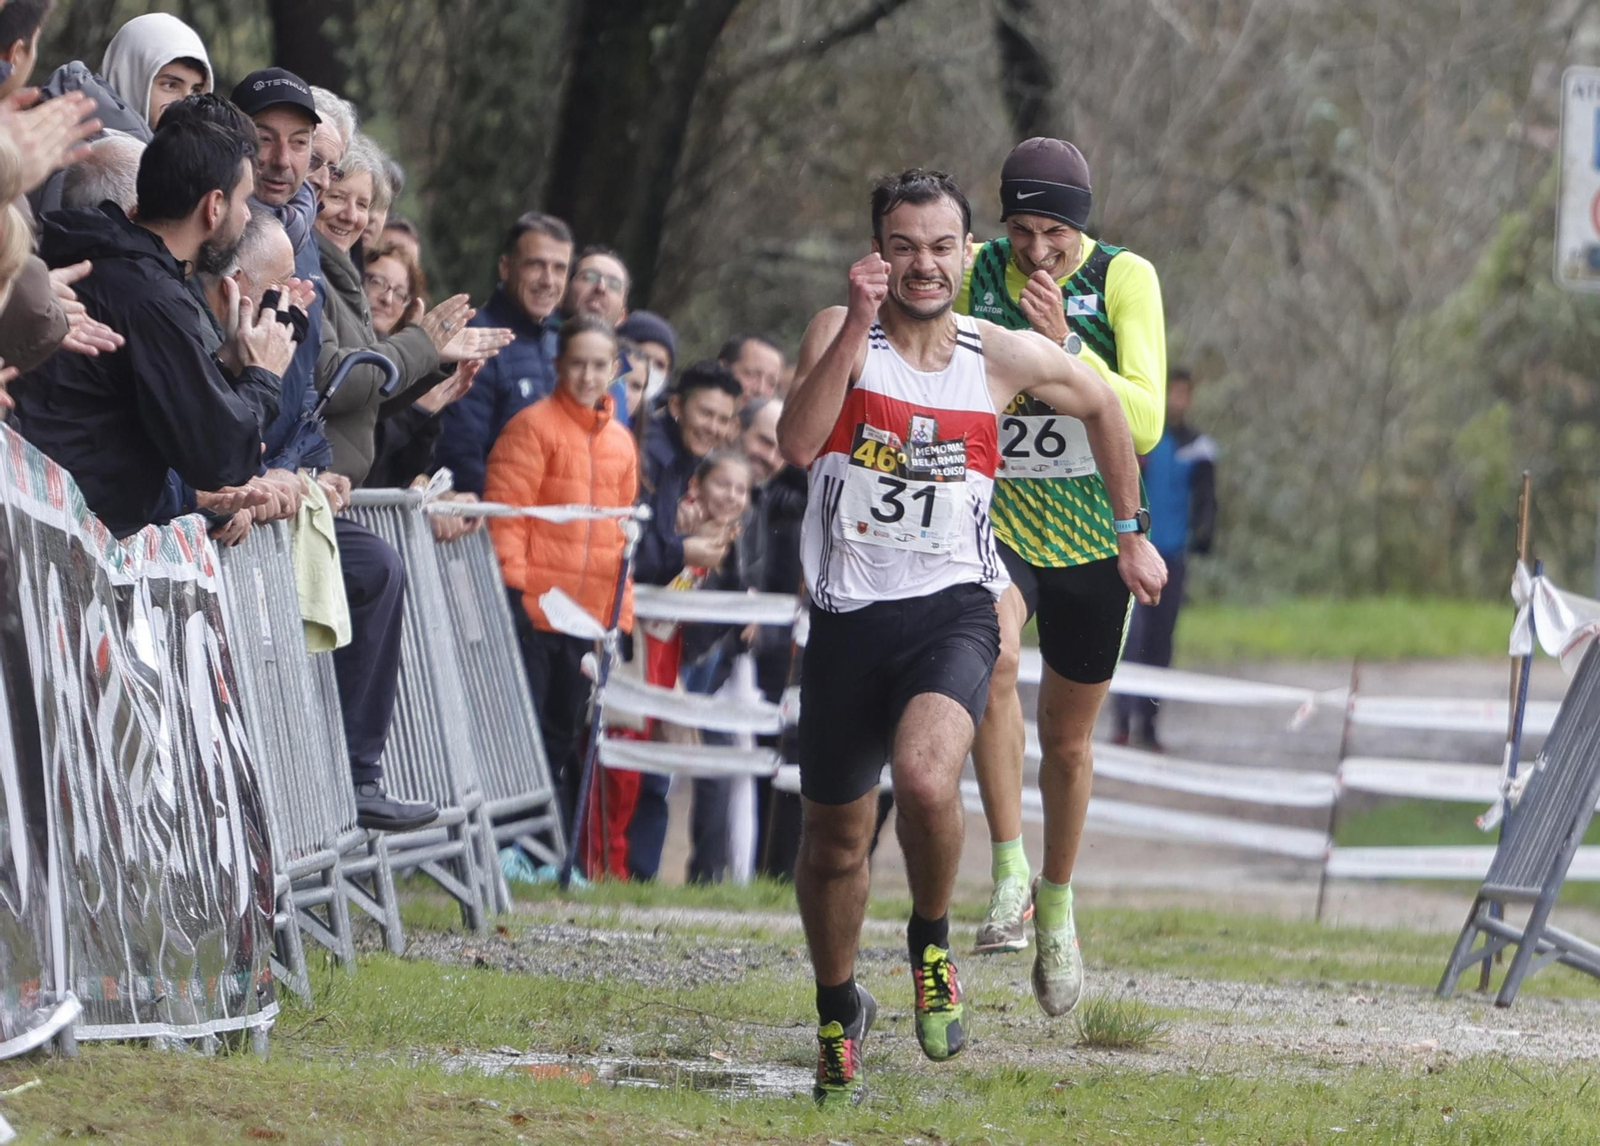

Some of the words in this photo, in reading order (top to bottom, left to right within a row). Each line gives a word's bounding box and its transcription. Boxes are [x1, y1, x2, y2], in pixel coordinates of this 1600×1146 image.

[974, 304, 1003, 315] VIATOR
[1002, 417, 1066, 458] 26
[915, 442, 965, 456] MEMORIAL
[911, 454, 966, 467] BELARMINO
[930, 466, 965, 476] ALONSO
[870, 475, 936, 528] 31
